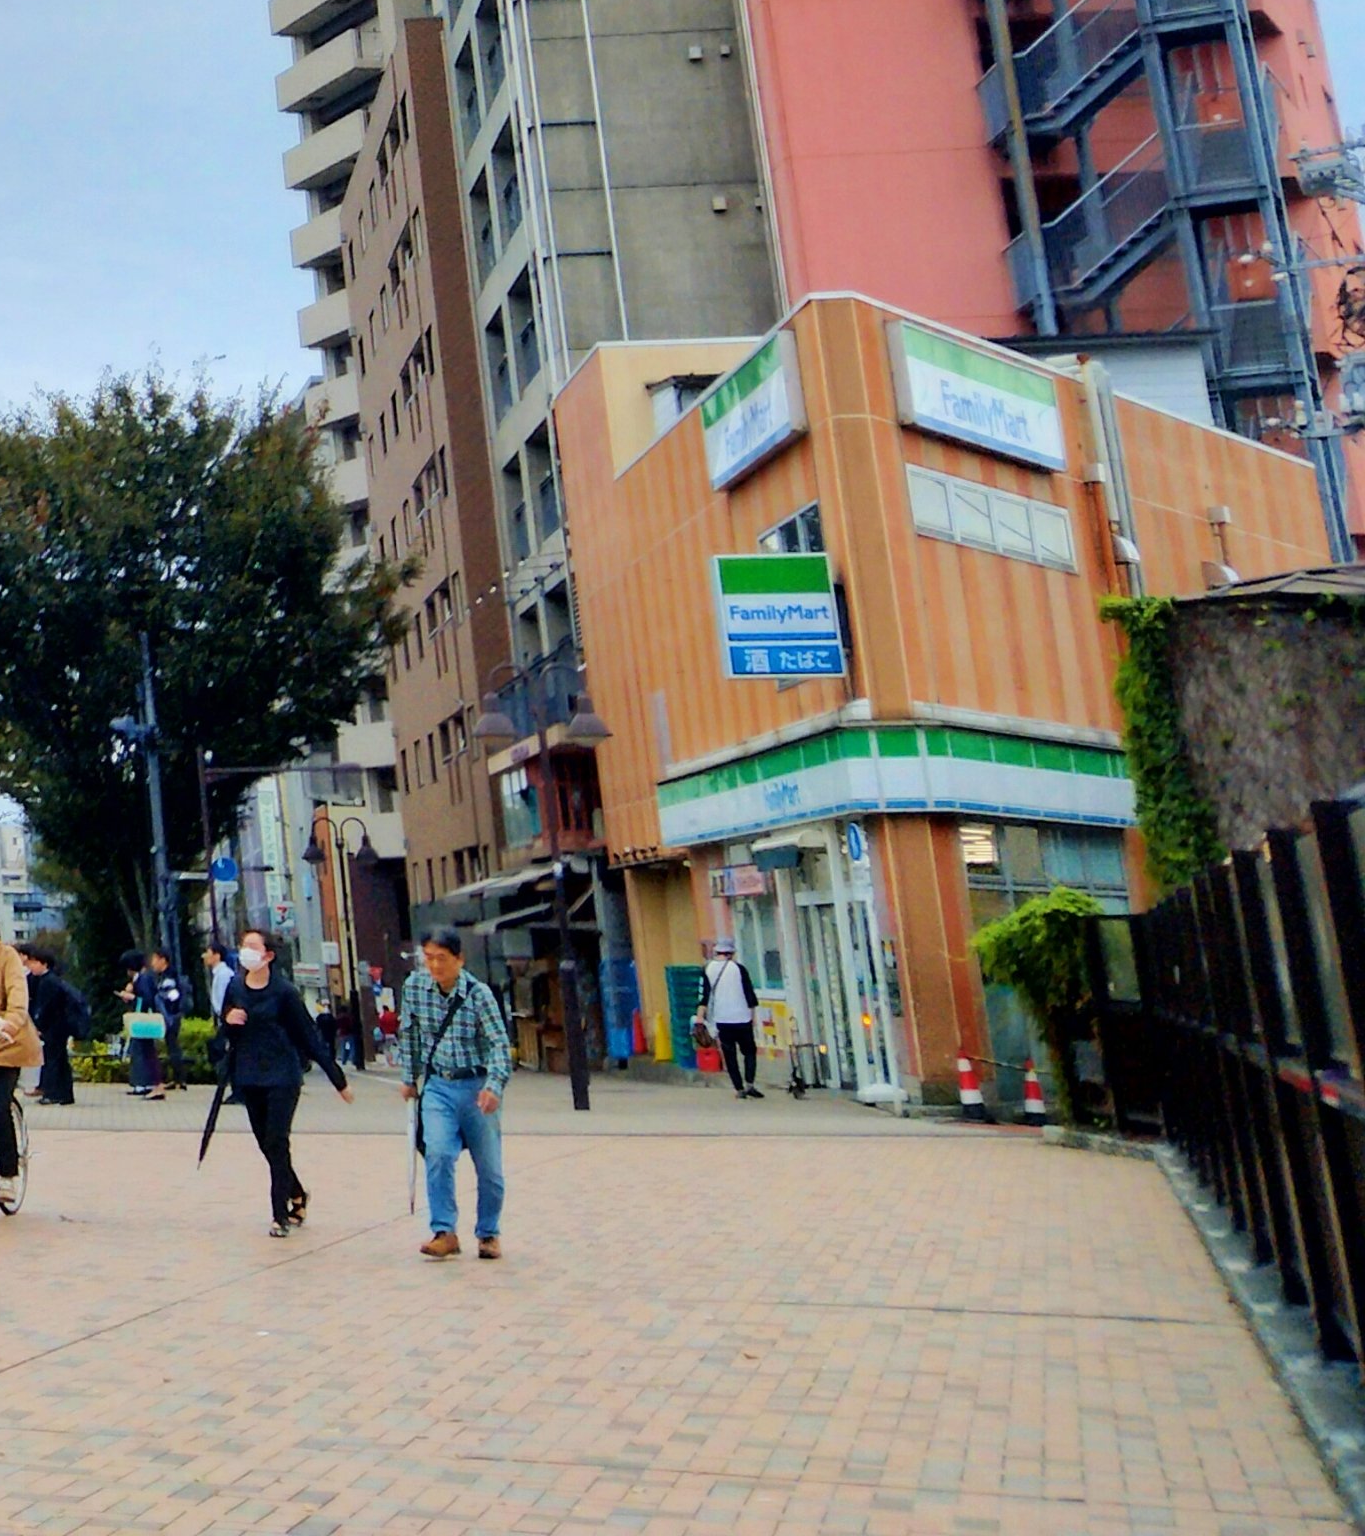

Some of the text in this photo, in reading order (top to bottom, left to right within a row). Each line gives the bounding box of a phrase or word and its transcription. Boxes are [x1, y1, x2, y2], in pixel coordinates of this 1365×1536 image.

[940, 379, 1031, 441] FamilyMart
[729, 605, 829, 624] FamilyMart
[744, 649, 832, 673] 酒 たばこ
